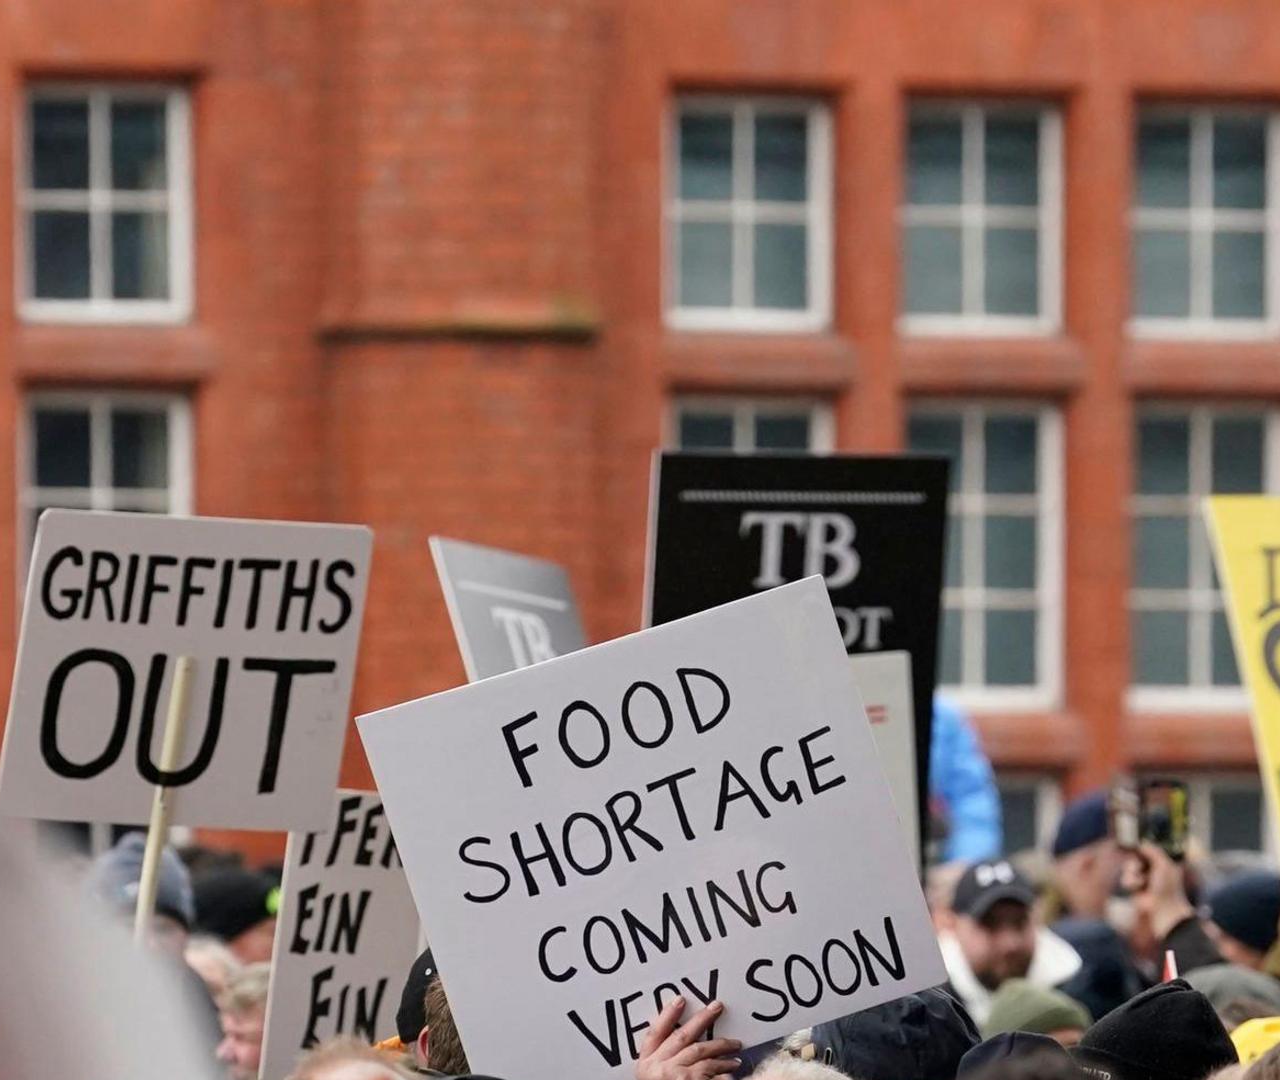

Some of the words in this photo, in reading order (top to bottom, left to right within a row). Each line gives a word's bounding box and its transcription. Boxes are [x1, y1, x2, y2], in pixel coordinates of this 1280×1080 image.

[41, 546, 355, 634] GRIFFITHS
[739, 512, 861, 589] TB
[40, 648, 336, 794] OUT
[502, 668, 731, 788] FOOD
[458, 726, 846, 903] SHORTAGE
[290, 884, 372, 955] EIN
[538, 861, 796, 983] COMING
[746, 916, 906, 1022] SOON
